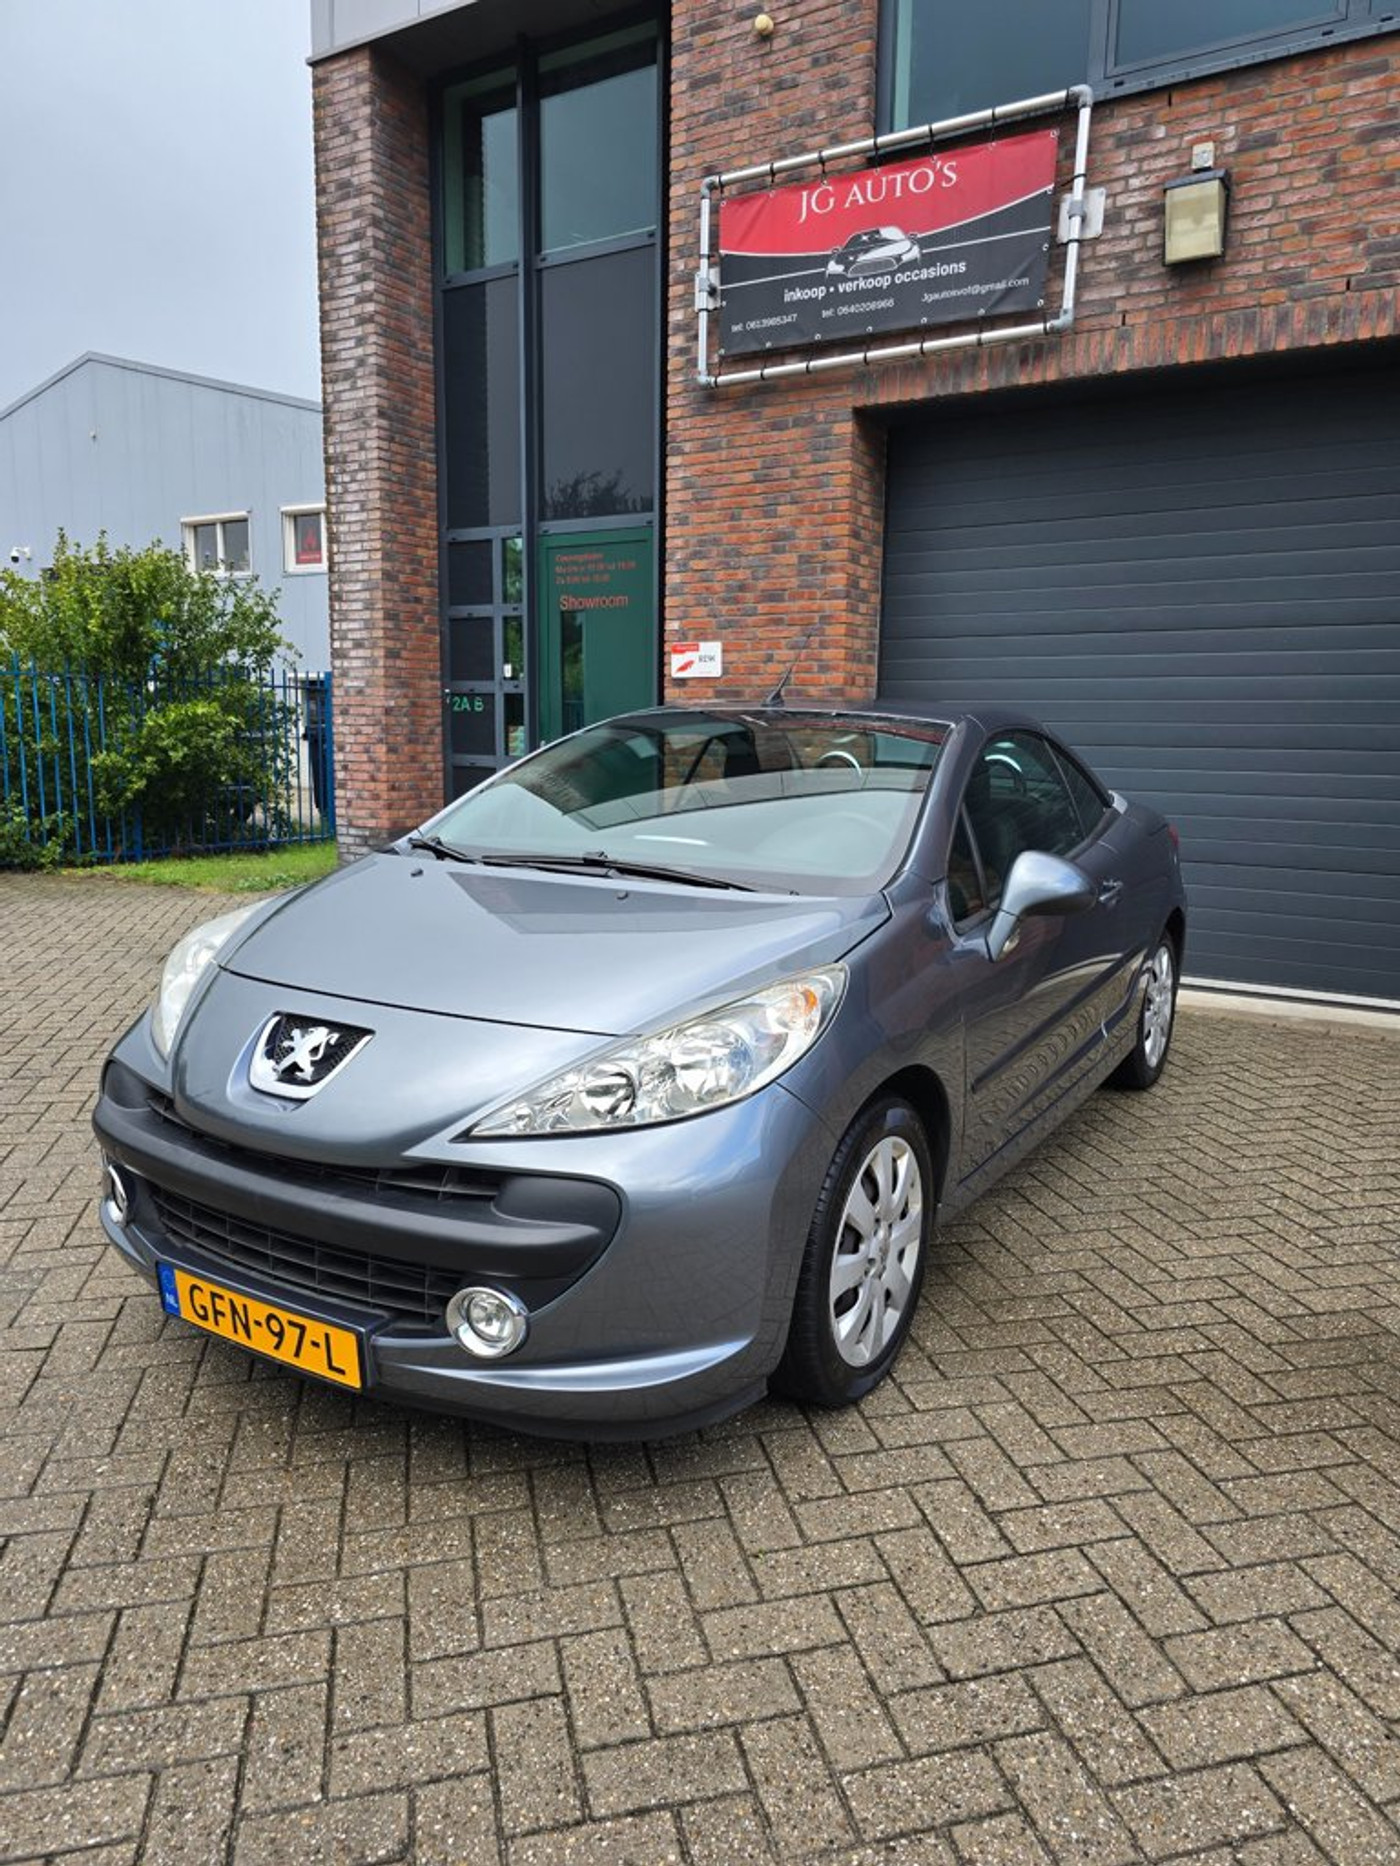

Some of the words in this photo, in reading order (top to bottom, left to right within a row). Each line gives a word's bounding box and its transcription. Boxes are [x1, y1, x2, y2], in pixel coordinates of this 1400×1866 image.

[798, 187, 834, 223] JG
[844, 162, 958, 209] AUTO'S
[784, 284, 827, 303] inkoop
[838, 273, 891, 294] verkoop
[895, 261, 967, 284] occasions
[560, 595, 628, 610] Showroom
[452, 696, 471, 712] 2A
[165, 1292, 178, 1308] NL
[189, 1283, 346, 1375] GFN-97-L
